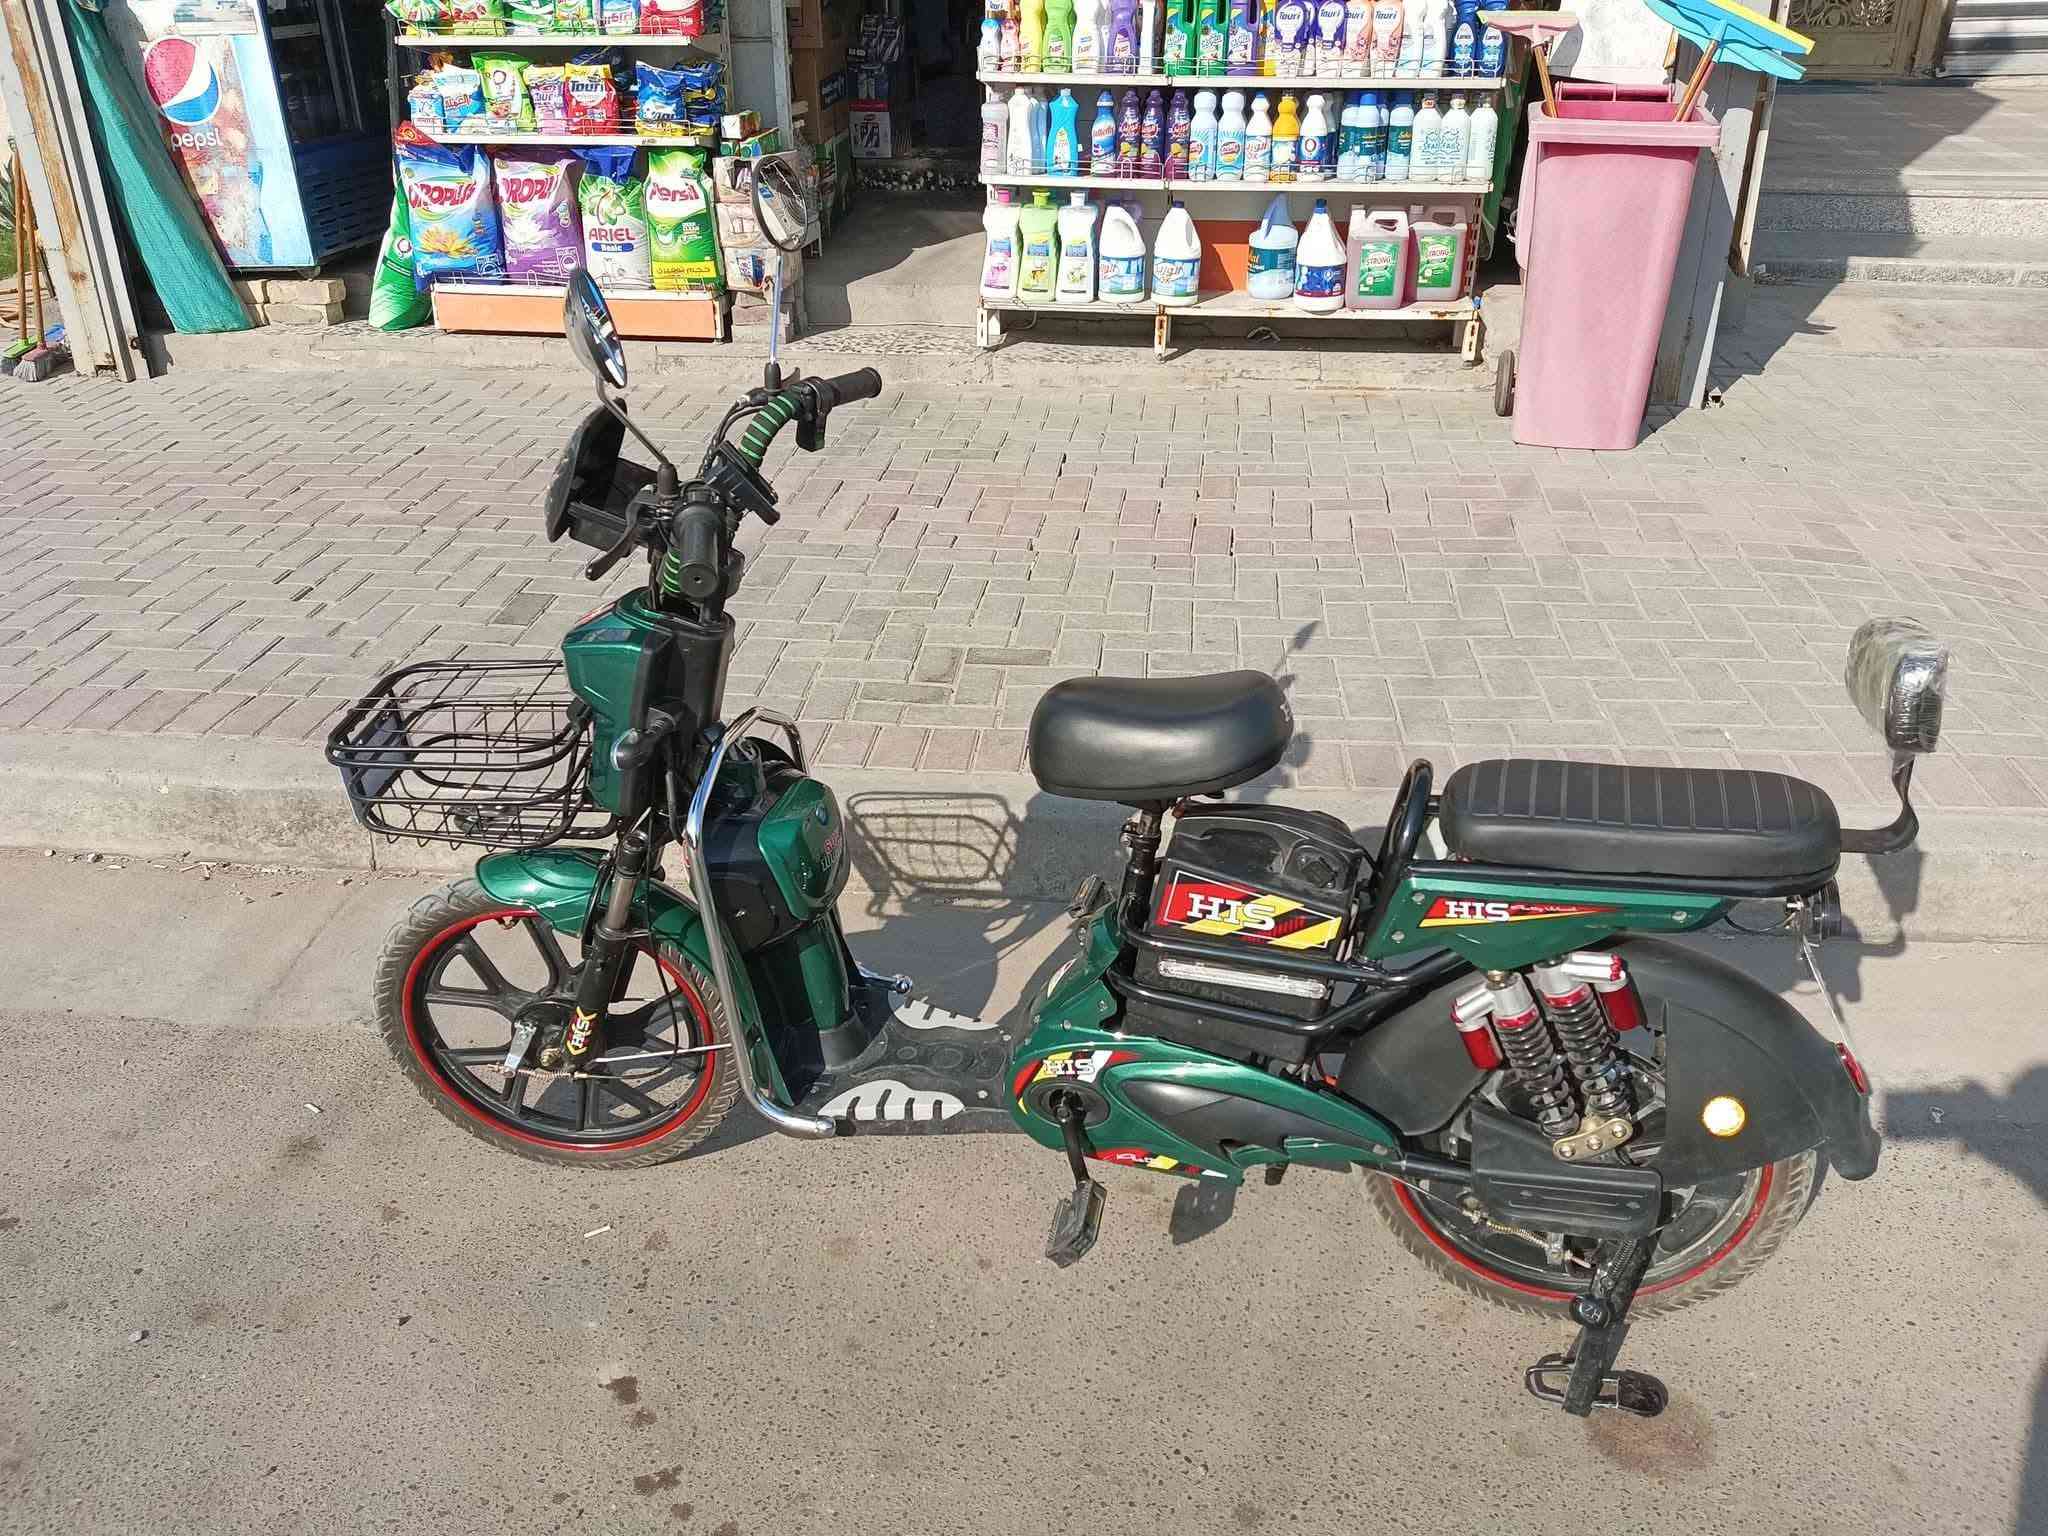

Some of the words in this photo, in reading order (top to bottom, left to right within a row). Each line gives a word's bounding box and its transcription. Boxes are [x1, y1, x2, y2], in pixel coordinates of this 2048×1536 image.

[589, 228, 635, 241] ARIEL
[1187, 892, 1276, 932] HIS
[1444, 900, 1511, 922] HIS
